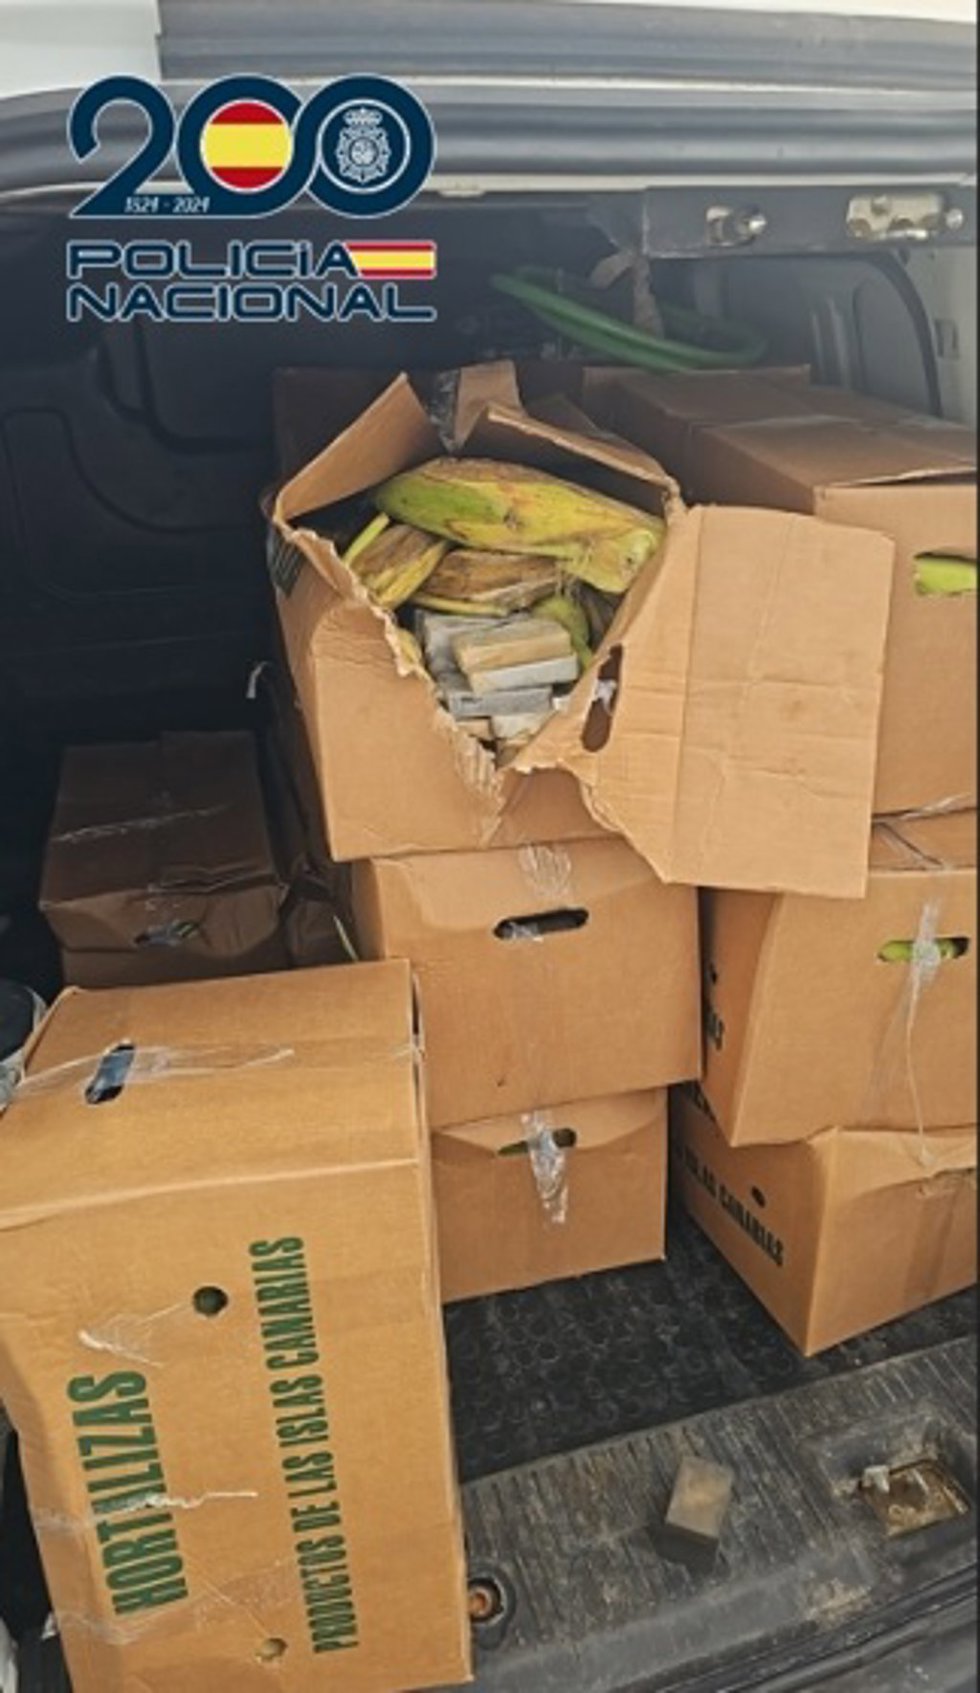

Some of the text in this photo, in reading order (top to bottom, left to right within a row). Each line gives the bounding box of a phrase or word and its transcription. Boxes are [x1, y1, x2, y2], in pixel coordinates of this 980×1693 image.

[249, 1236, 359, 1654] PRODUCTOS DE LAS ISLAS CANARIAS
